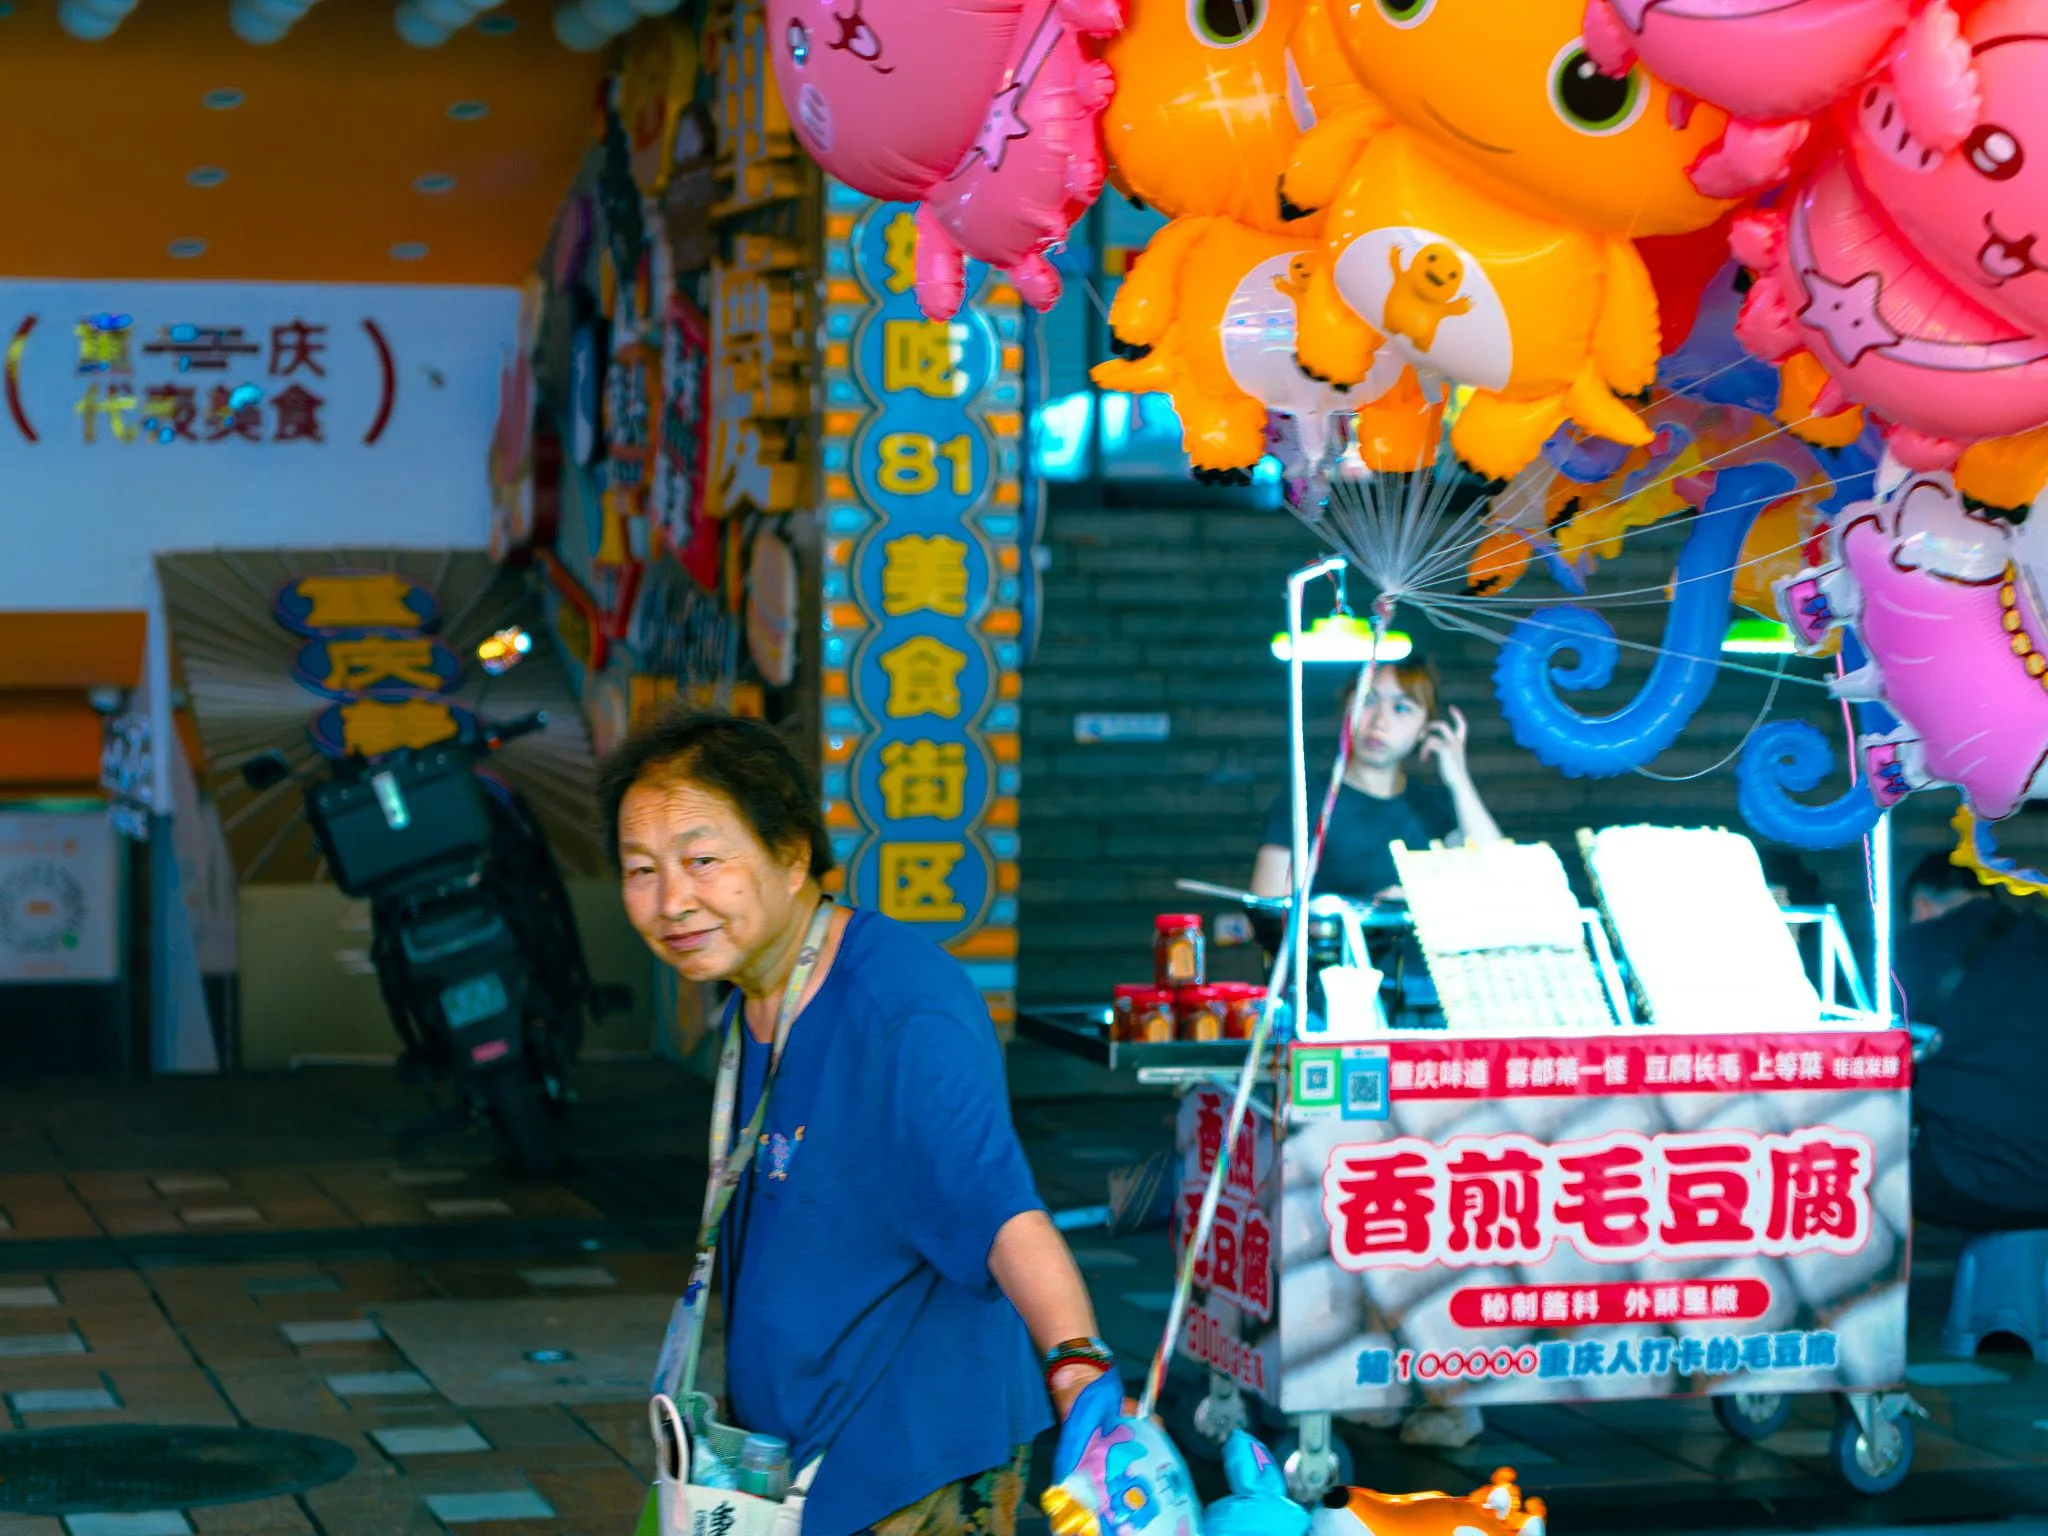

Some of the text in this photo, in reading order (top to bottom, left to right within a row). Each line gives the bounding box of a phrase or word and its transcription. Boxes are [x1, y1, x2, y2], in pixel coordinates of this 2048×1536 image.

[1391, 1058, 1489, 1090] 重庆味道
[1645, 1052, 1741, 1084] 豆腐长毛
[1336, 1140, 1861, 1256] 香煎毛豆腐
[1481, 1289, 1600, 1324] 秘制酱料
